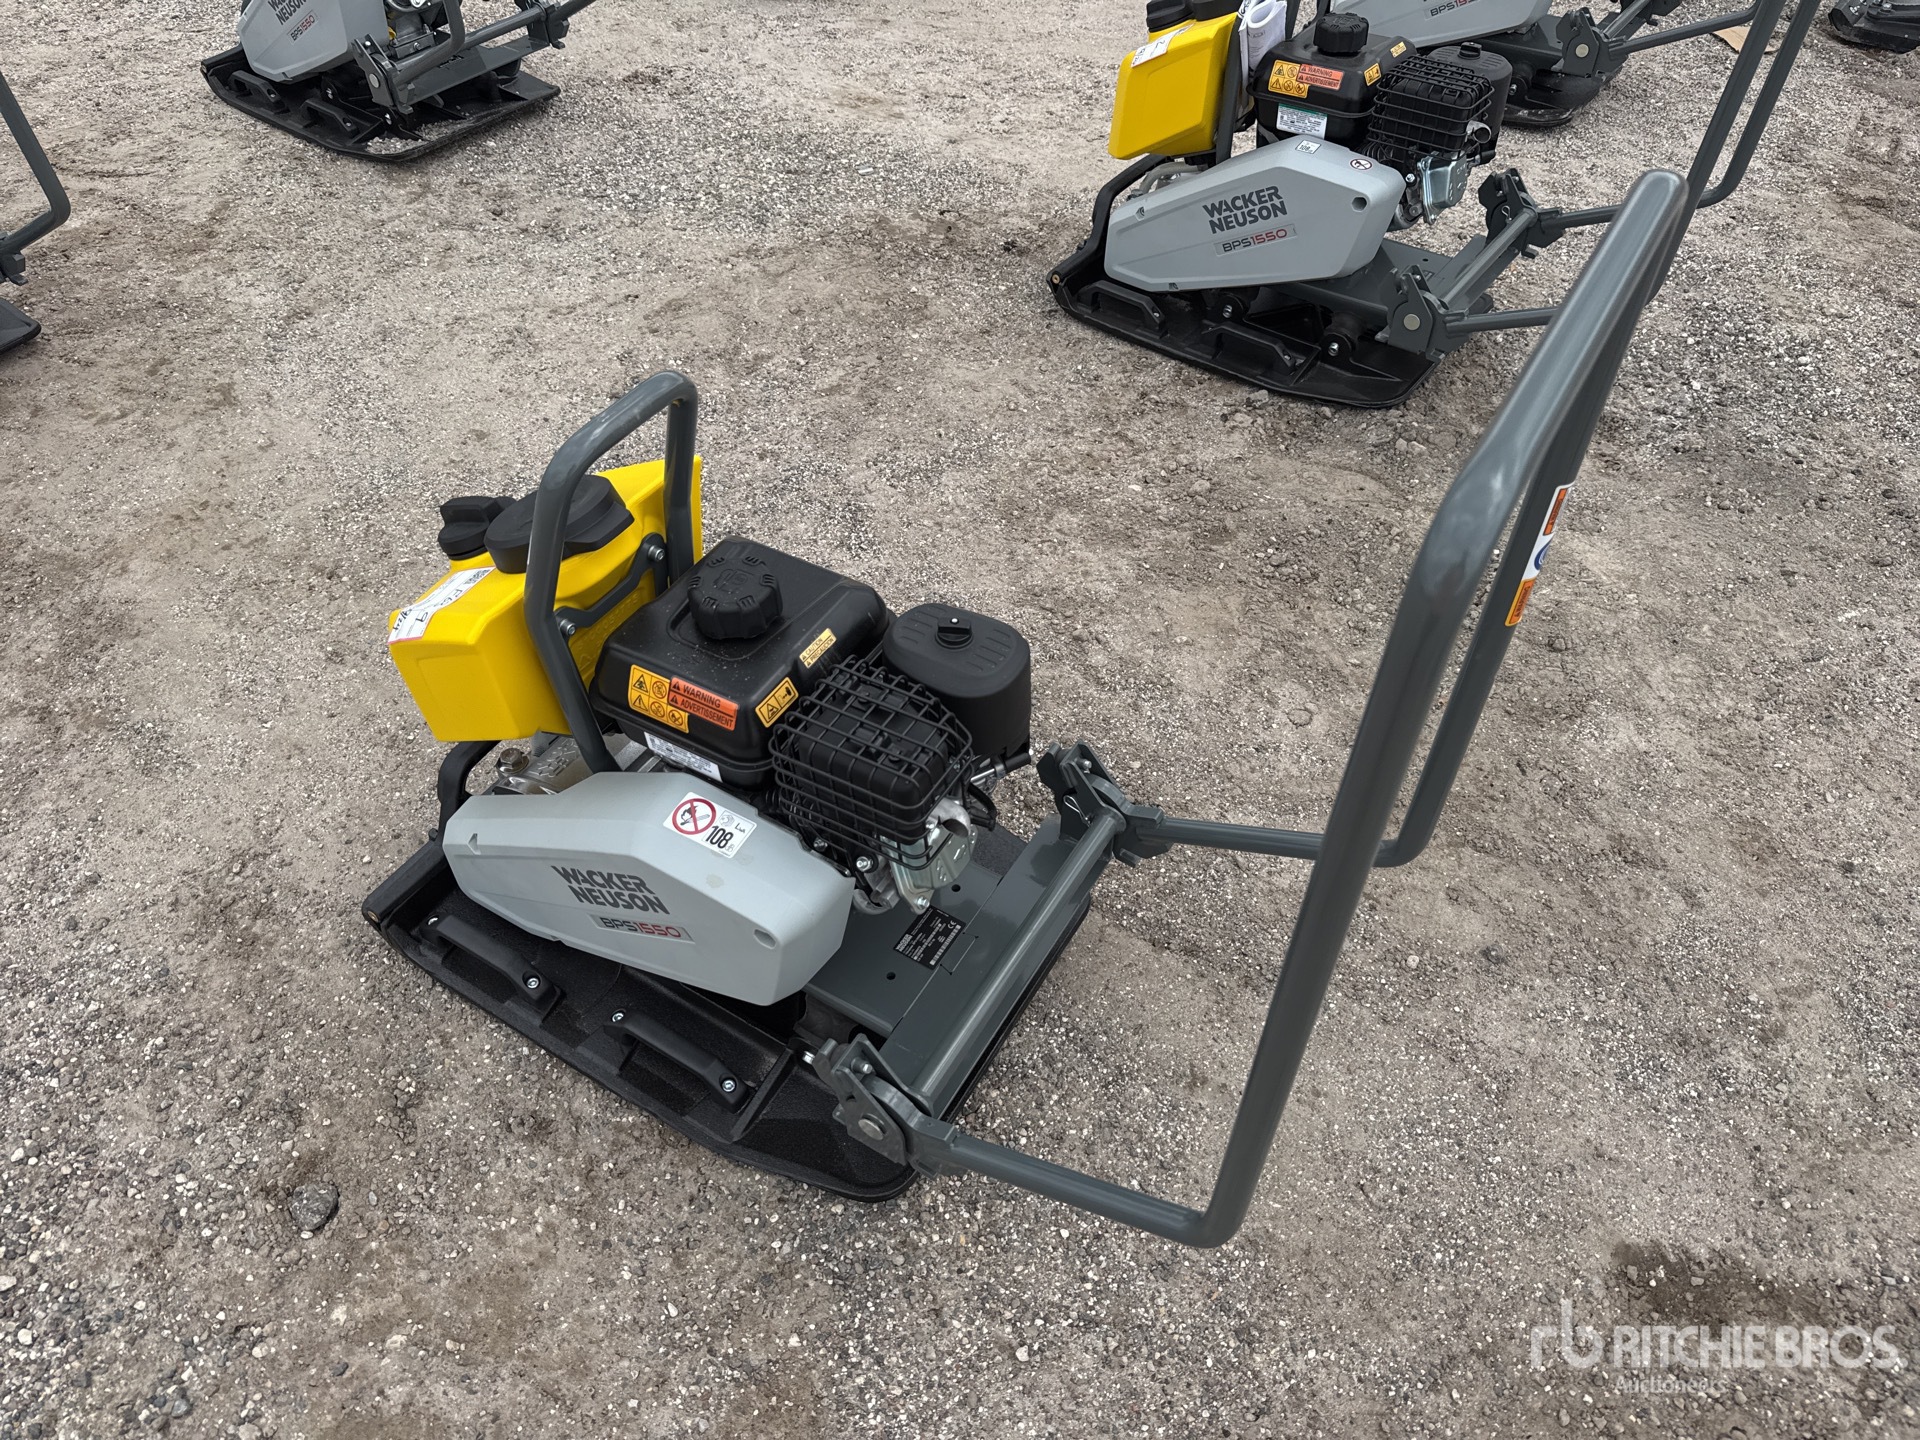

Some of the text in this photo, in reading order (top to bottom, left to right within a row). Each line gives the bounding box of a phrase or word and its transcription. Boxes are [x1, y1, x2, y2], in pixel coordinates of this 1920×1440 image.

[290, 14, 316, 41] BPS1550
[1307, 65, 1333, 77] WARNING
[1202, 185, 1283, 218] WACKER
[1208, 200, 1287, 234] NEUSON
[1222, 228, 1288, 252] BPS1550
[682, 684, 721, 708] WARNING
[680, 698, 734, 728] ADVERTISSEMENT
[705, 825, 734, 849] 108
[551, 865, 656, 895] WACKER
[567, 885, 670, 915] NEUSON
[599, 917, 681, 938] BPS1550
